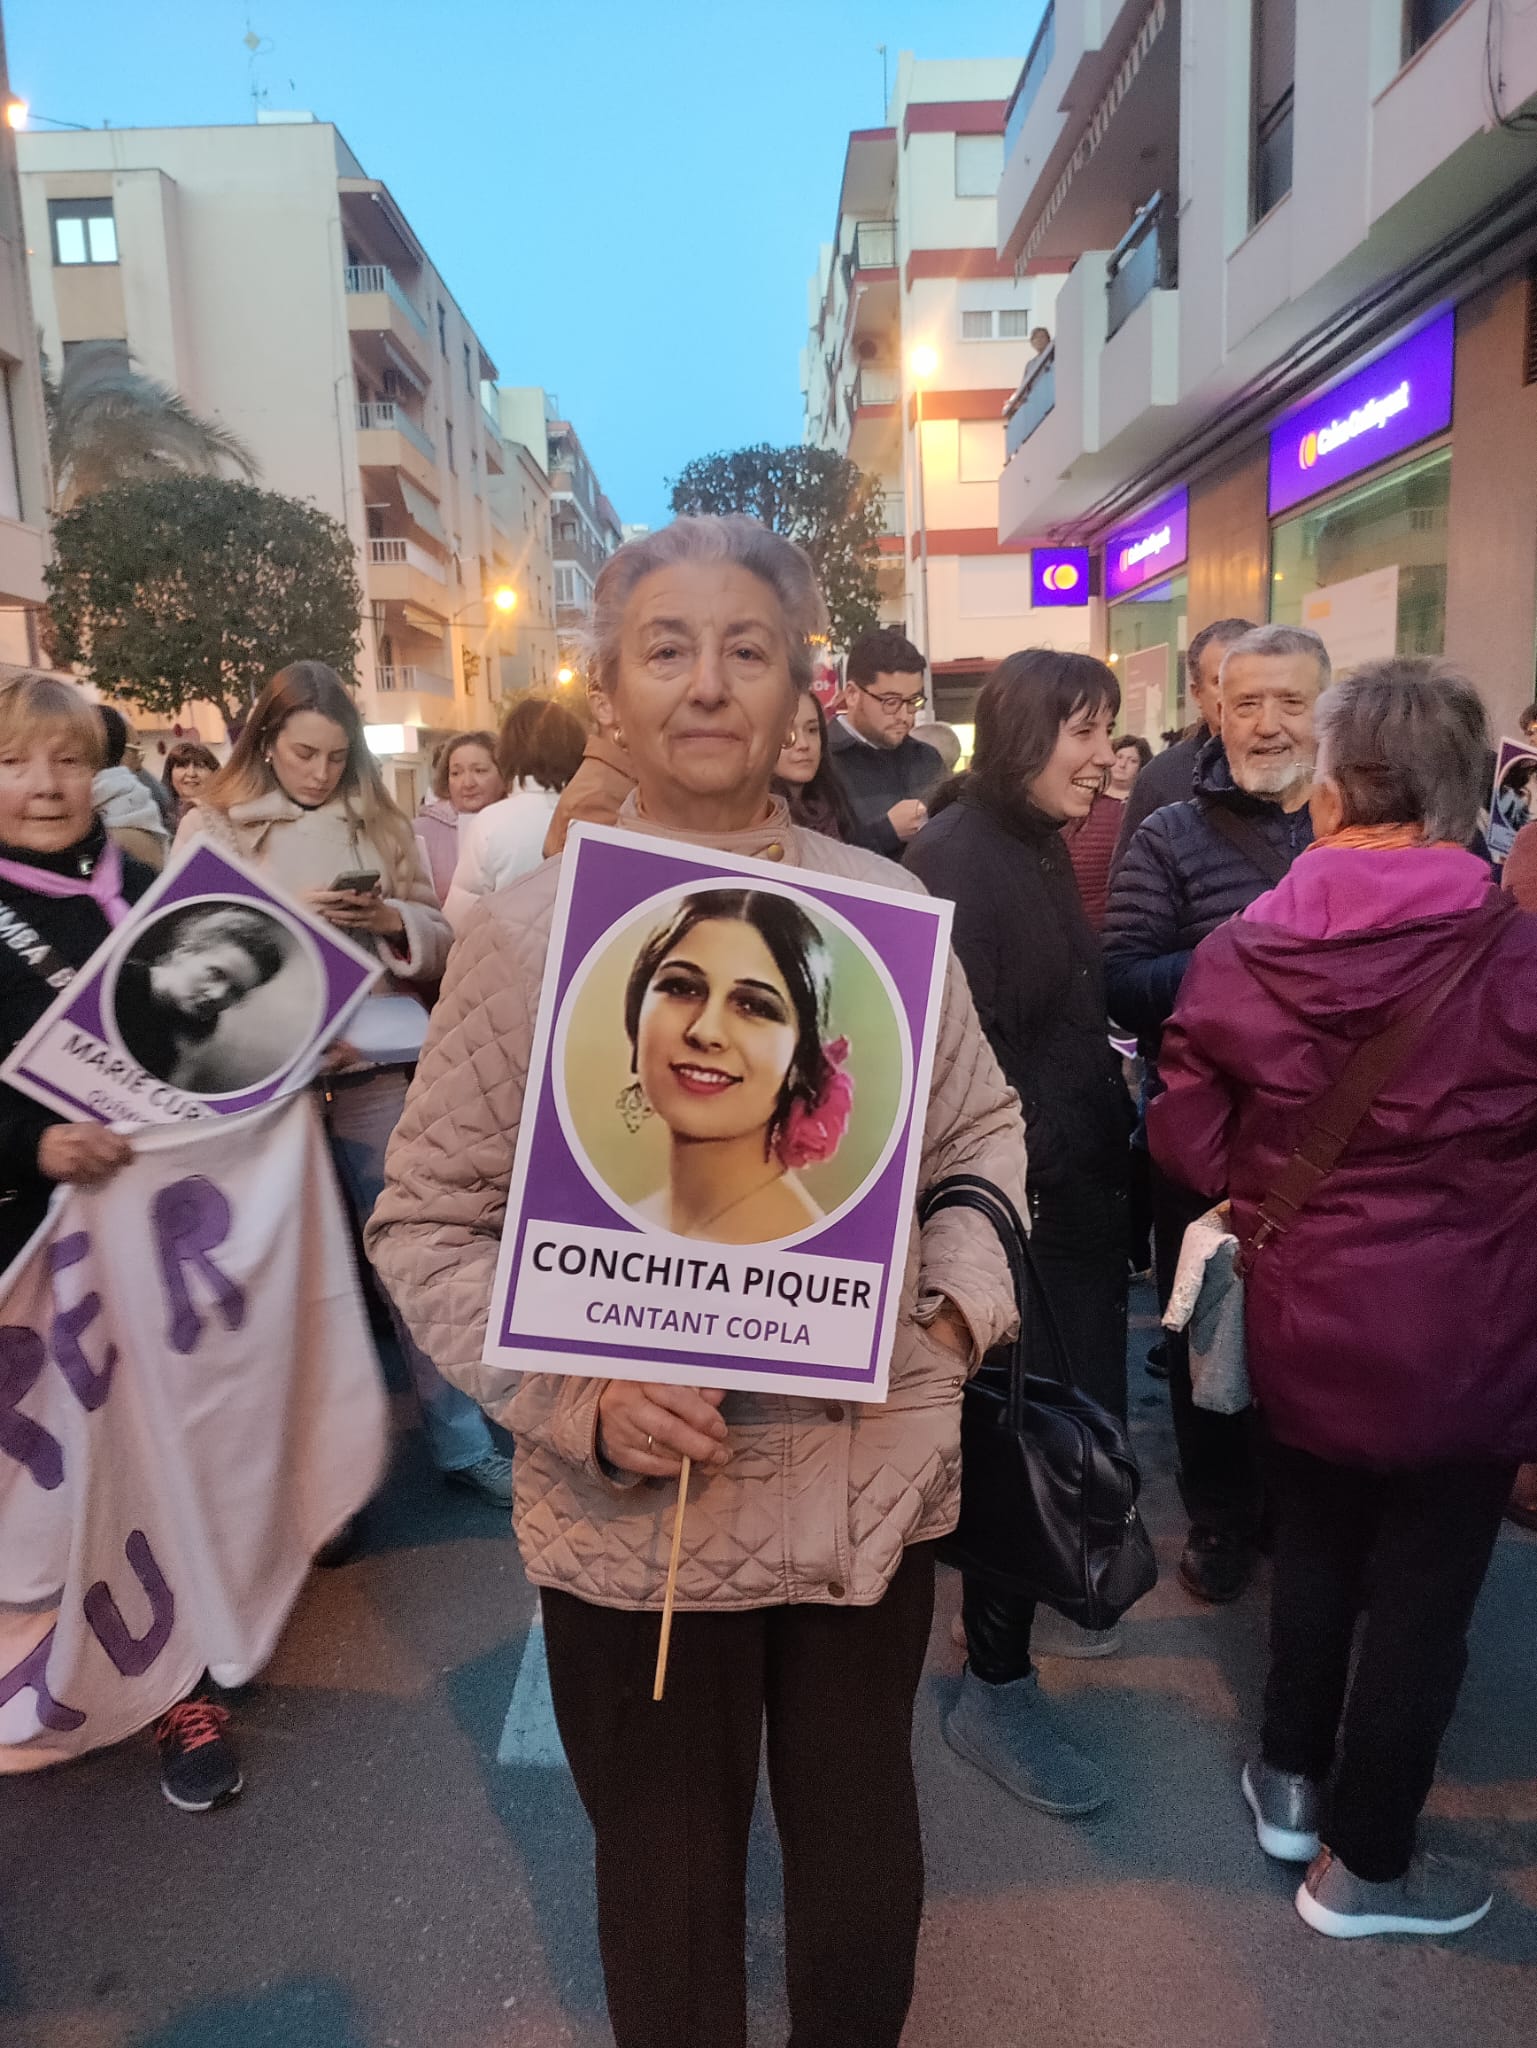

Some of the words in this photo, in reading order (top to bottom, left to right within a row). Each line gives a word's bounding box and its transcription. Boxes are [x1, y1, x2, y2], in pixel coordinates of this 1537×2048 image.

[63, 1034, 147, 1094] MARIE
[532, 1241, 730, 1294] CONCHITA
[743, 1266, 872, 1309] PIQUER
[585, 1301, 720, 1337] CANTANT
[726, 1316, 811, 1346] COPLA
